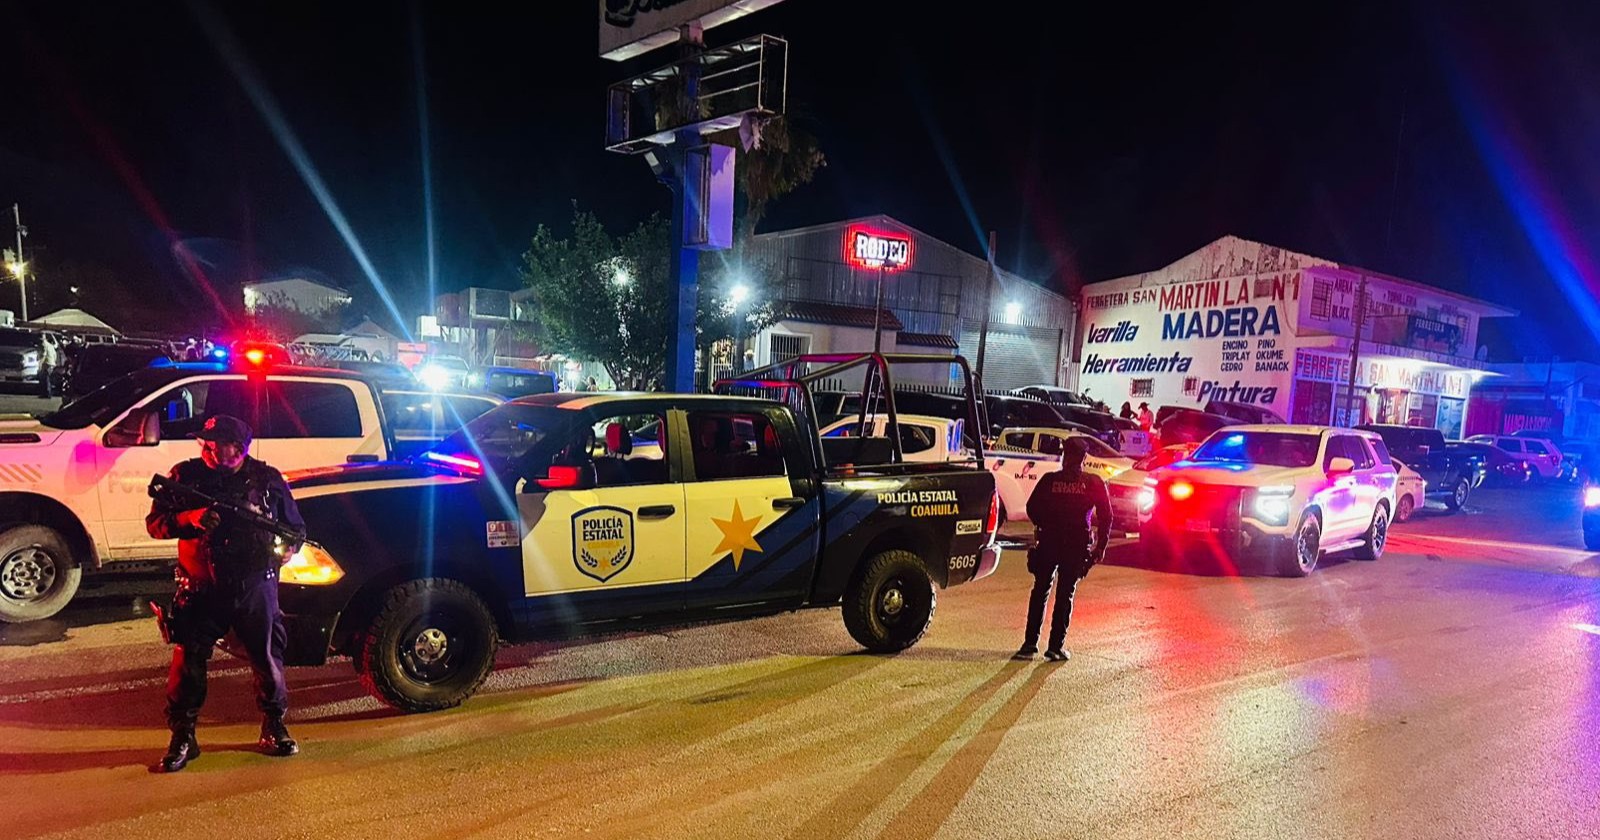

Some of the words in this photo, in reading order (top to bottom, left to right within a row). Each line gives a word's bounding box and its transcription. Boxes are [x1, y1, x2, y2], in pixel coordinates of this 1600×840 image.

[856, 233, 907, 265] RODEO
[1132, 289, 1157, 304] SAN
[1159, 281, 1221, 311] MARTIN
[1223, 278, 1249, 306] LA
[1332, 304, 1349, 320] BLOCK
[1162, 305, 1281, 340] MADERA
[1088, 321, 1139, 344] Varilla
[1222, 340, 1248, 350] ENCINO
[1258, 339, 1275, 349] PINO
[1082, 351, 1193, 374] Herramienta
[1222, 351, 1250, 361] TRIPLAY
[1256, 350, 1284, 360] OKUME
[1220, 362, 1243, 372] CEDRO
[1255, 361, 1289, 372] BANACK
[1295, 352, 1364, 384] FERRETEA
[1197, 380, 1278, 404] Pintura
[877, 490, 918, 504] POLICÍA
[919, 490, 958, 502] ESTATAL
[911, 504, 959, 517] COAHUILA
[582, 516, 623, 530] POLICÍA
[582, 528, 624, 541] ESTATAL
[949, 554, 977, 570] 5605
